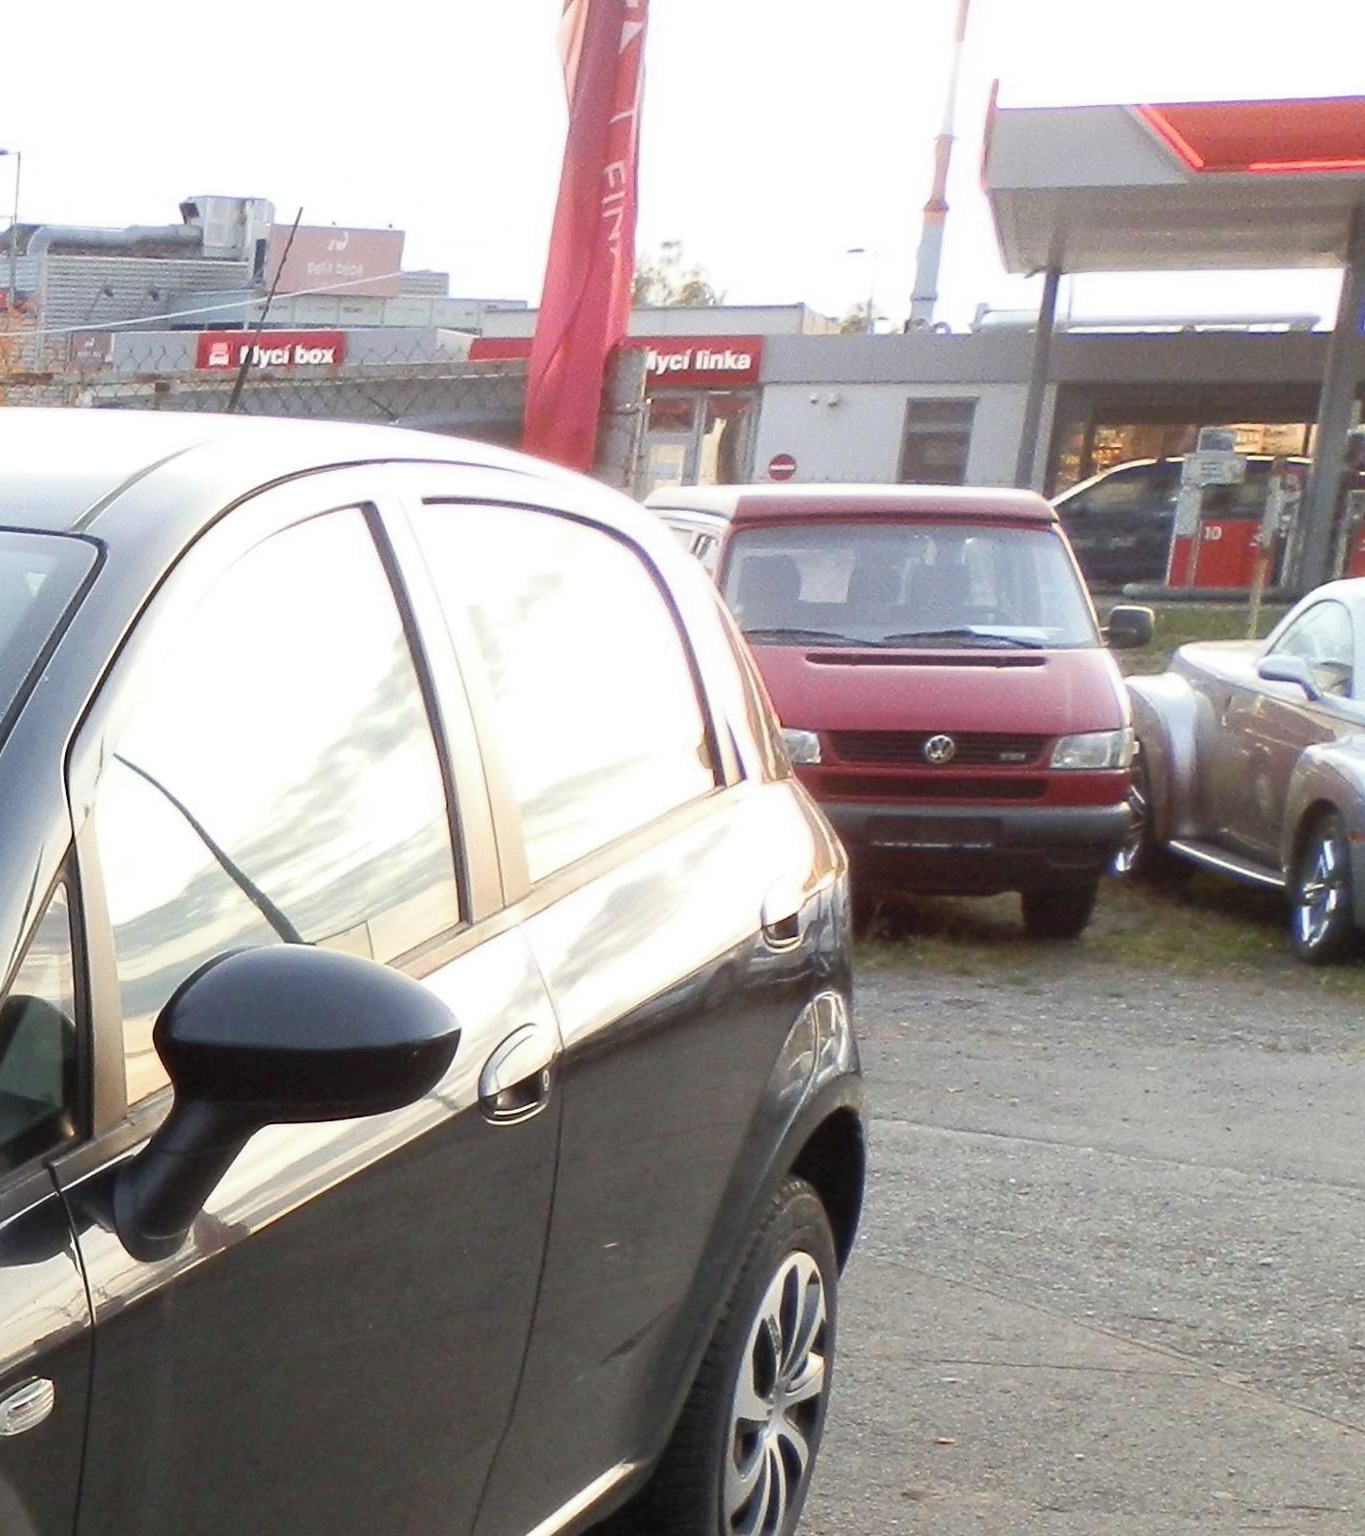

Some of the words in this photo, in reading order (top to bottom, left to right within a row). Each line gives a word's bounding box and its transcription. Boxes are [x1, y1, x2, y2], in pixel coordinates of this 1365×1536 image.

[293, 345, 337, 365] box
[694, 349, 752, 371] linka
[1204, 526, 1222, 541] 10
